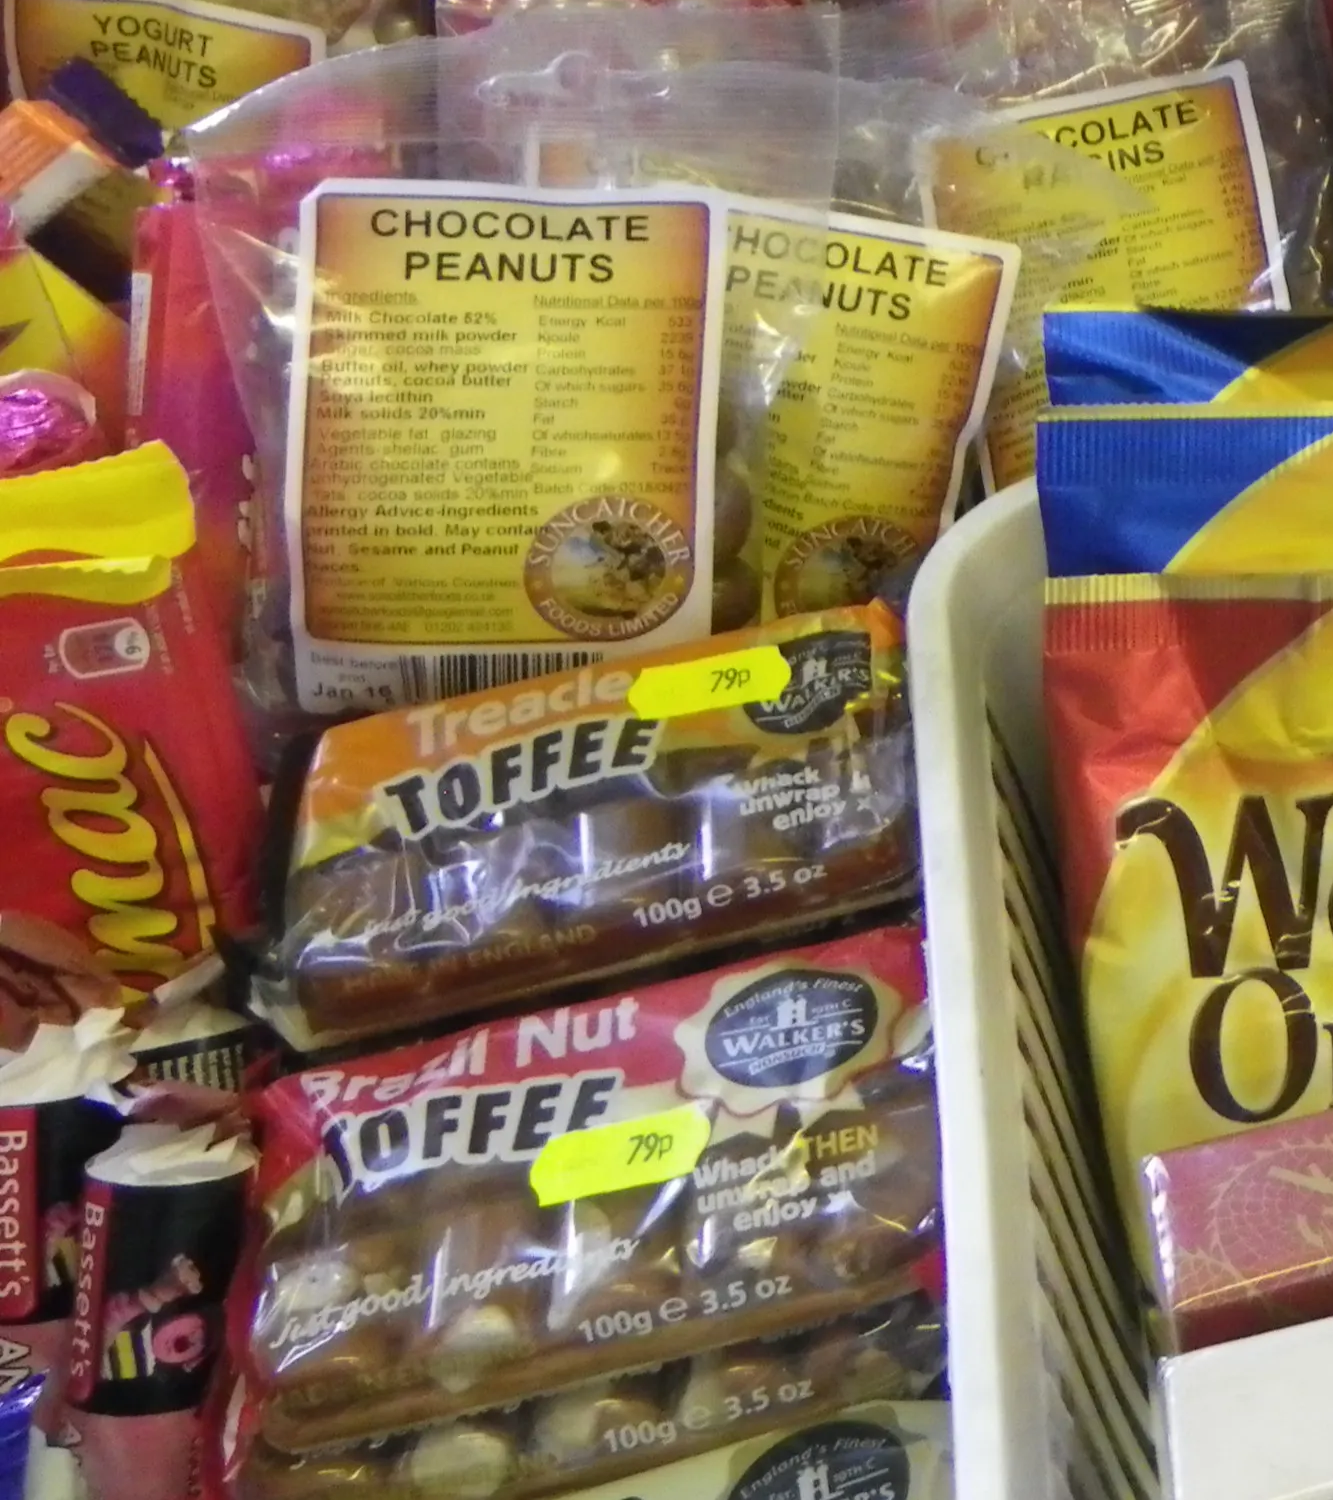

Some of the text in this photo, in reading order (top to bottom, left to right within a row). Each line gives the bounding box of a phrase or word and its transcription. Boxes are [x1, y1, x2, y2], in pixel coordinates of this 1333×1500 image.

[92, 13, 214, 59] YOGURT
[90, 40, 218, 89] PEANUTS
[975, 98, 1200, 170] CCOLATE
[370, 208, 651, 242] CHOCOLATE
[403, 250, 615, 283] PEANUTS
[727, 219, 950, 288] HOCOLATE
[725, 265, 912, 322] PEANUTS
[348, 543, 520, 557] Sesame and Peanut
[526, 495, 693, 569] SUNCATCHER
[539, 595, 602, 637] FOODS
[607, 592, 680, 636] LIMITED
[710, 667, 751, 693] 79p
[405, 666, 636, 759] Treacle
[385, 716, 660, 834] TOFFEE
[772, 799, 846, 833] enjoy
[300, 995, 640, 1110] Brazil Nut
[721, 1016, 867, 1058] WALKER'S
[321, 1074, 619, 1194] TOFFEE
[626, 1134, 674, 1166] 79p
[819, 1150, 878, 1188] and
[0, 1129, 32, 1298] Bassett's
[732, 1190, 819, 1233] enjoy
[69, 1201, 105, 1379] Bassett's
[269, 1307, 338, 1349] just
[338, 1272, 432, 1328] good
[738, 1443, 829, 1499] England's
[833, 1436, 887, 1451] Finest
